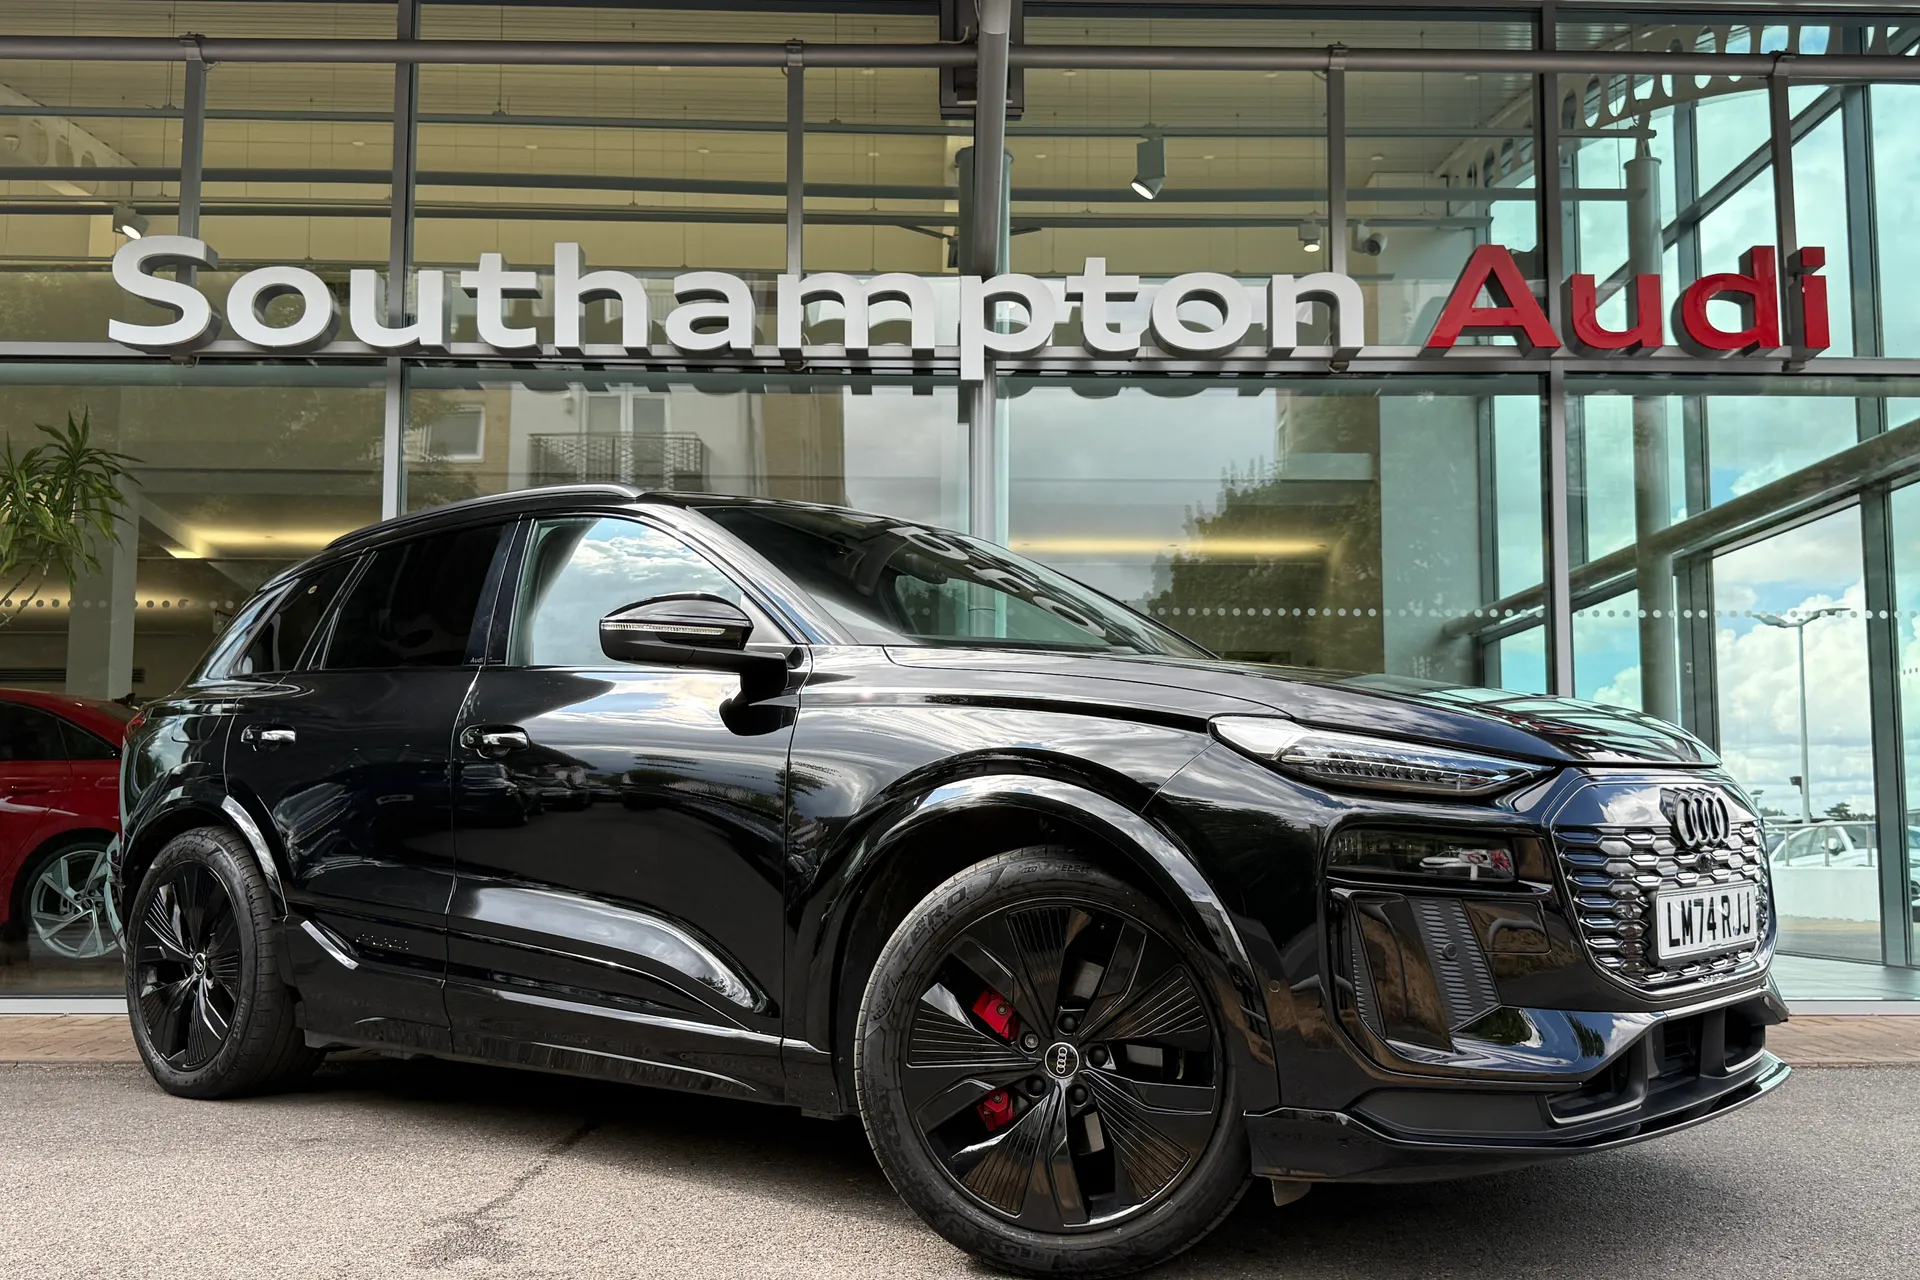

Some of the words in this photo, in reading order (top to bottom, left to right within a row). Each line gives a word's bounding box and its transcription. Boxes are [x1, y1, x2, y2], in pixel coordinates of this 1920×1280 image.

[108, 235, 1365, 381] Southampton
[1424, 244, 1830, 358] Audi
[1667, 896, 1717, 948] LM74
[1721, 891, 1751, 939] RJJ
